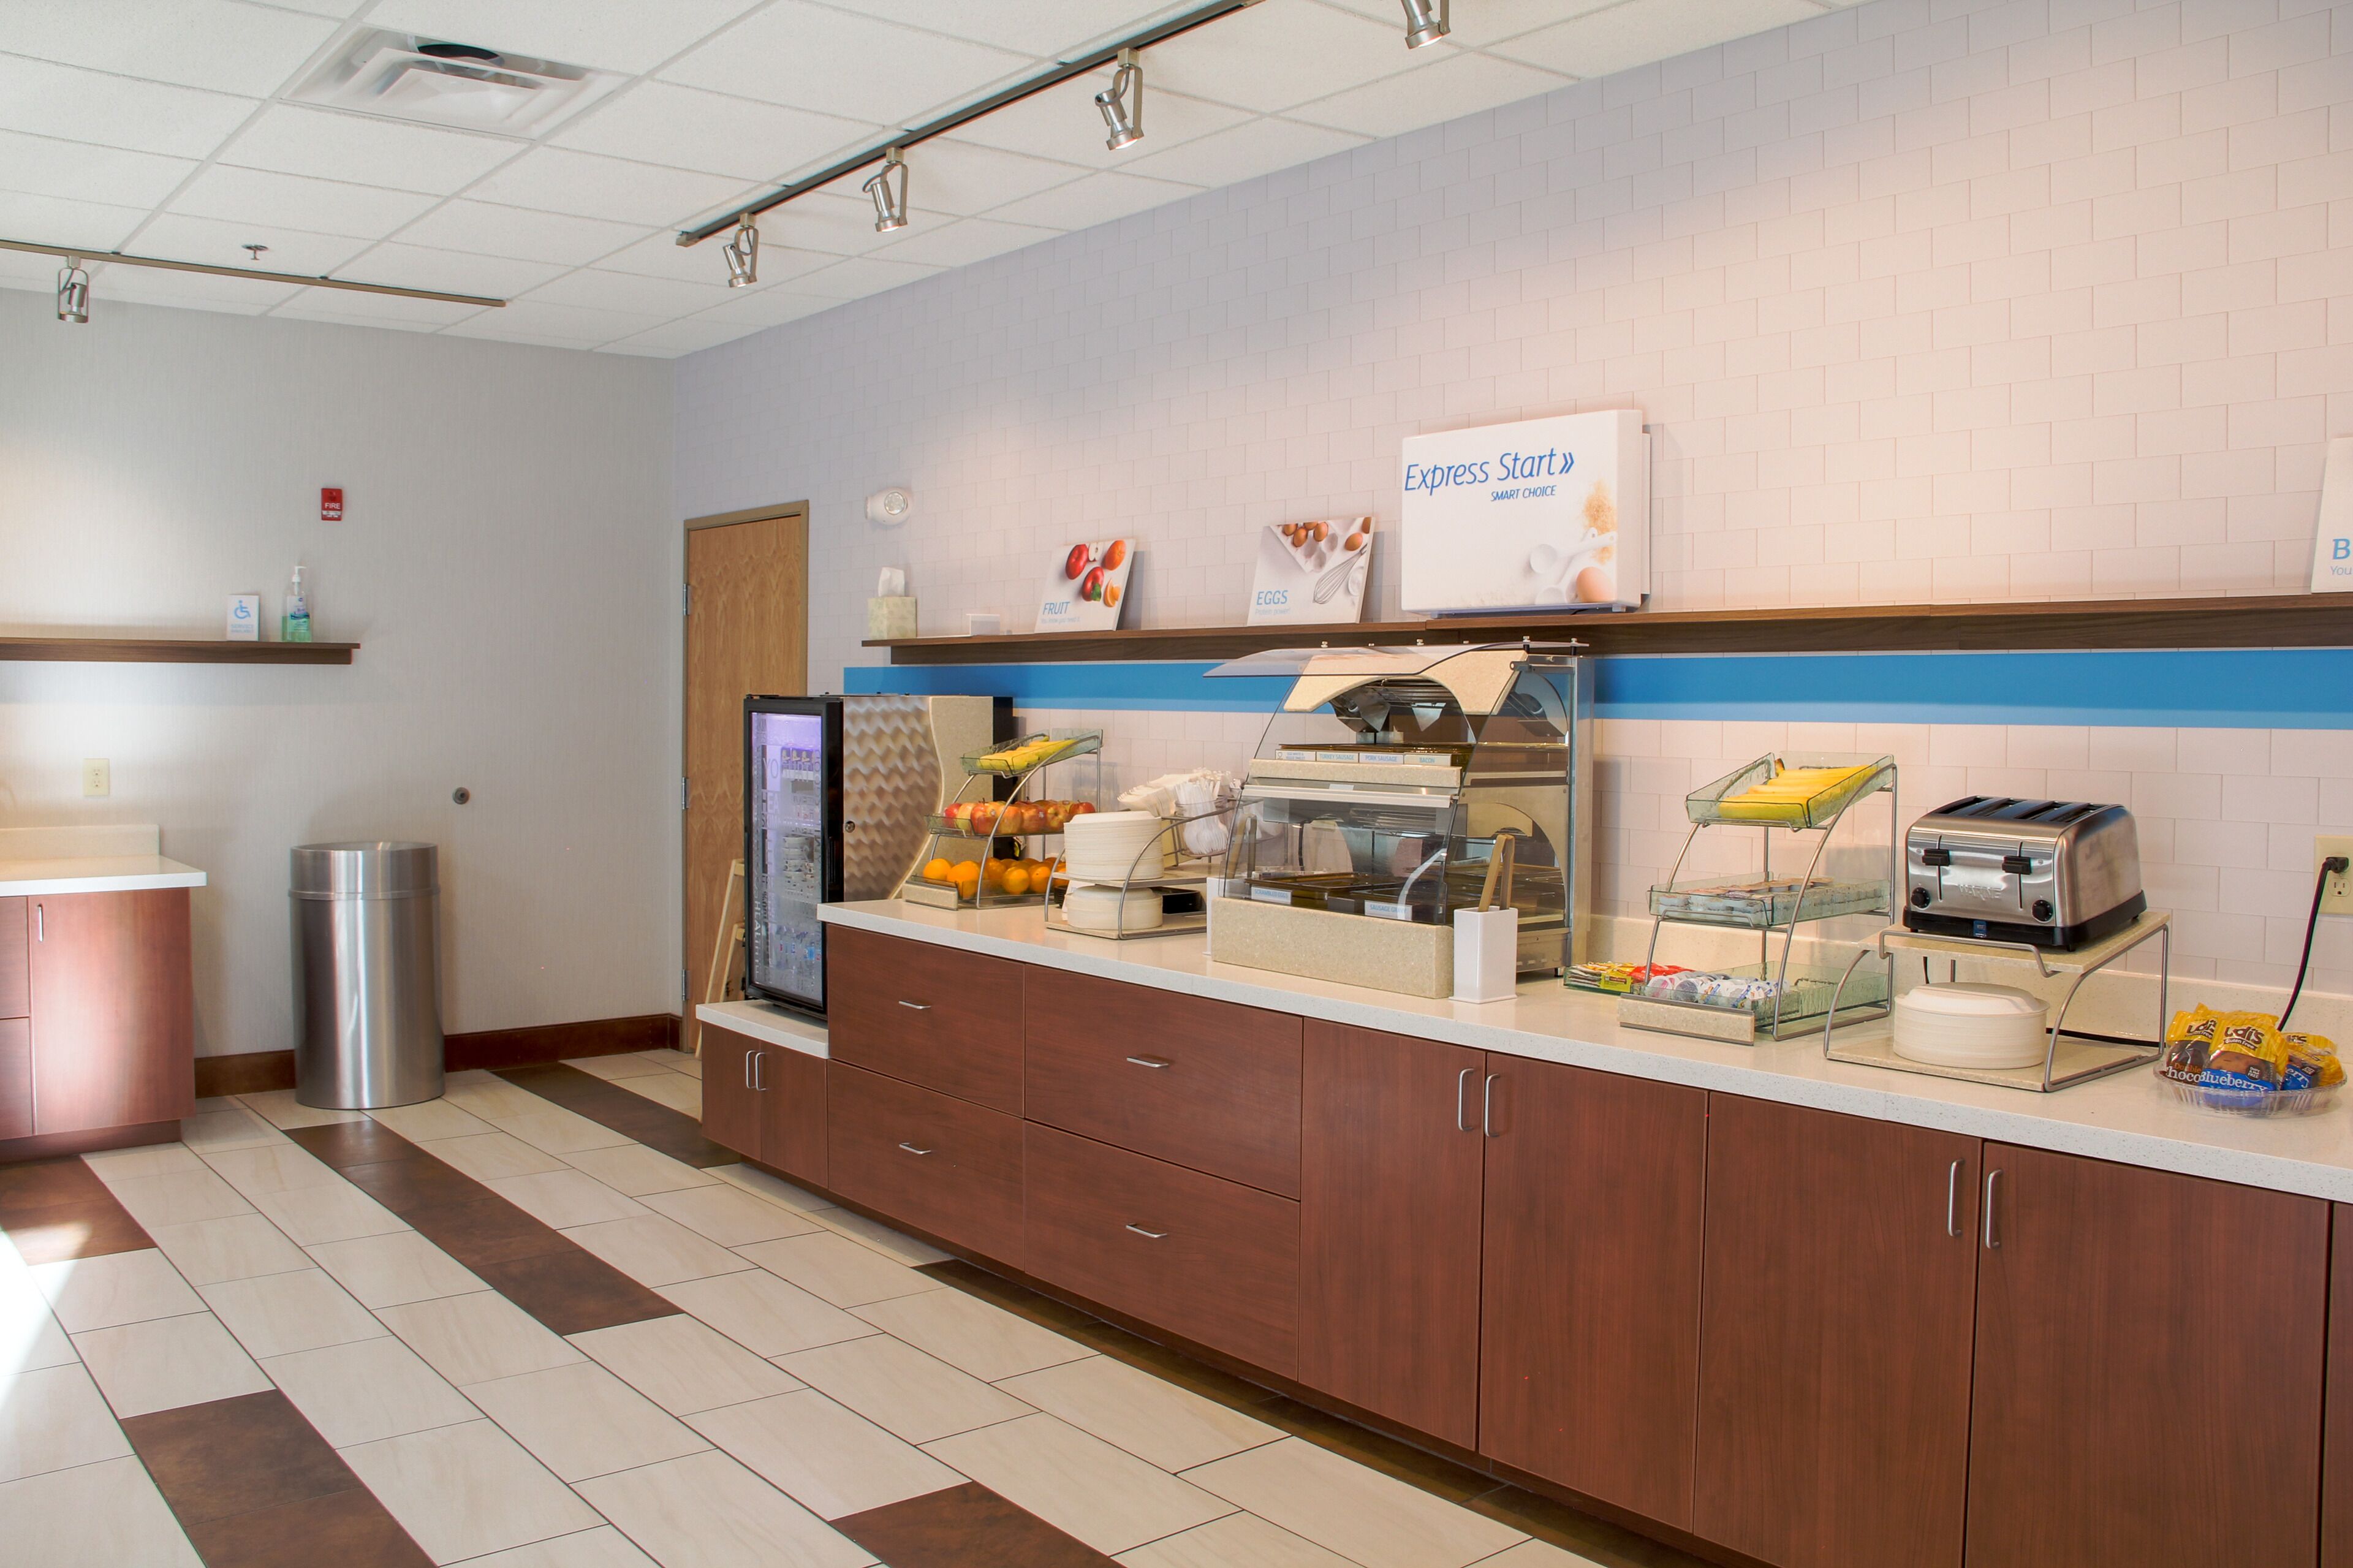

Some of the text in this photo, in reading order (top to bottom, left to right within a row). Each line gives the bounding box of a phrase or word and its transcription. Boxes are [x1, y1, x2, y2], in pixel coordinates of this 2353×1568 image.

[1404, 461, 1490, 496] Express
[1491, 485, 1557, 501] SMART CHOICE
[1257, 590, 1289, 605] EGGS
[1043, 602, 1070, 615] FRUIT
[1370, 904, 1390, 912] SAUSAGE
